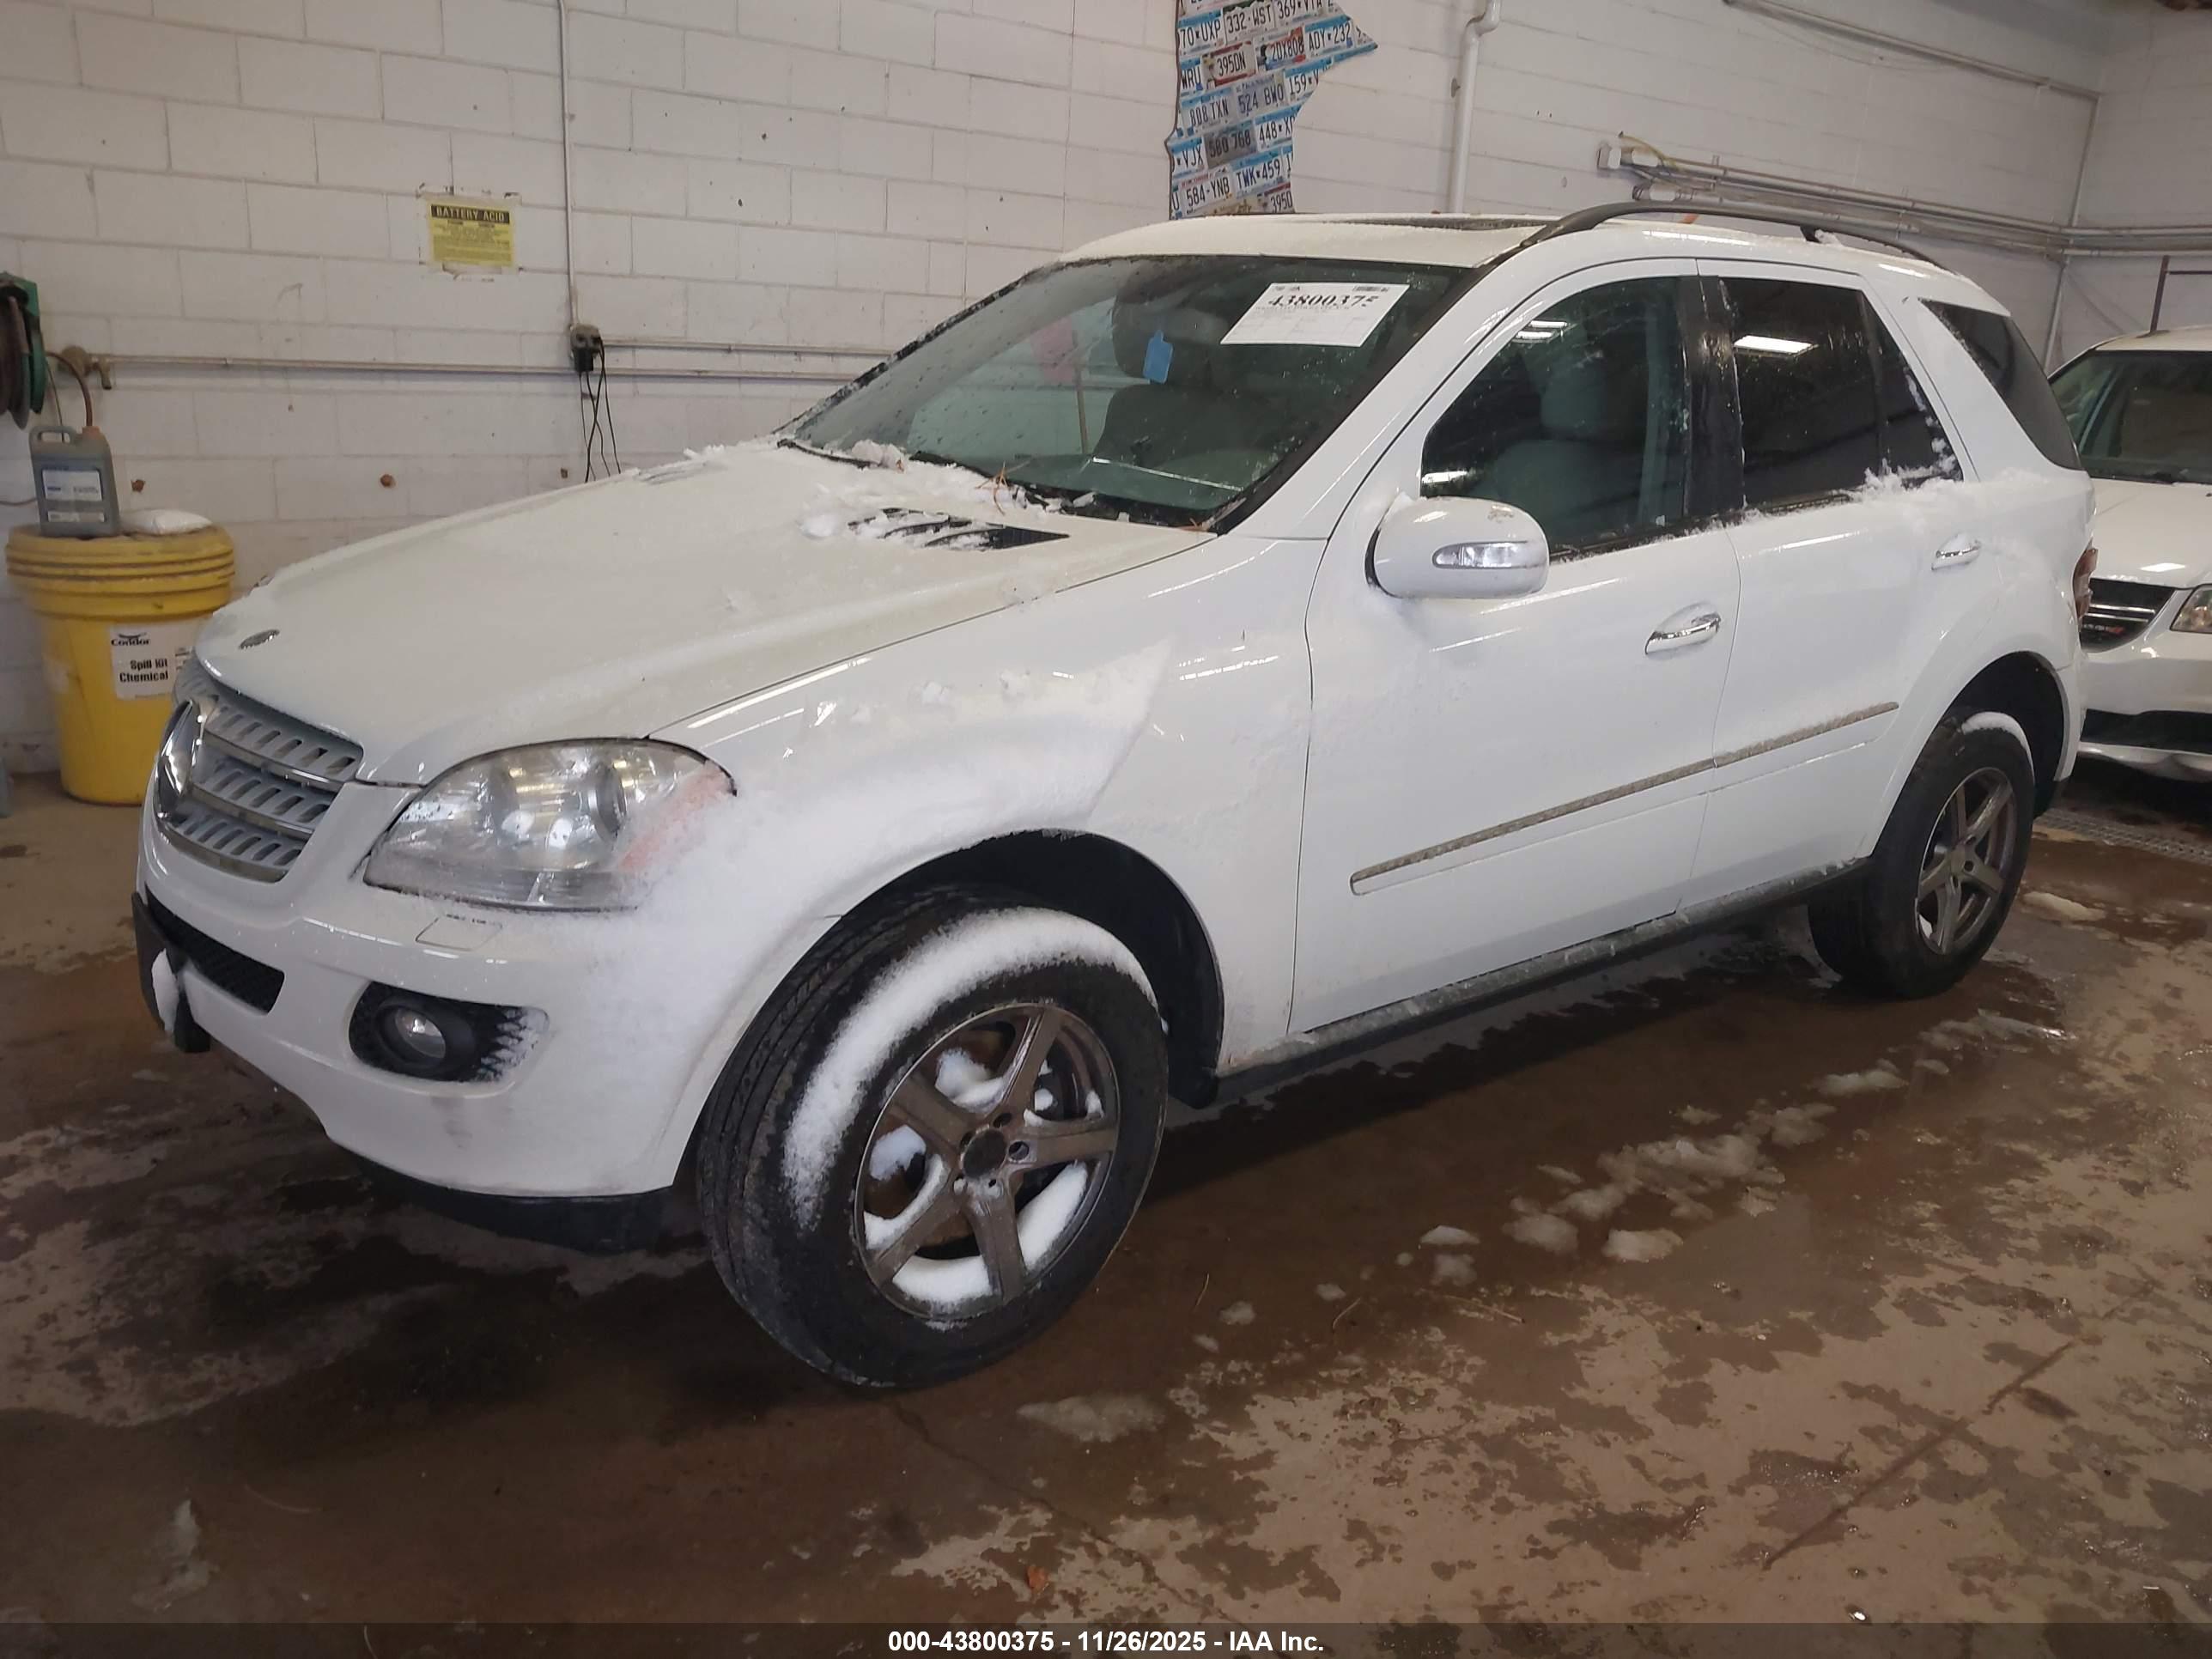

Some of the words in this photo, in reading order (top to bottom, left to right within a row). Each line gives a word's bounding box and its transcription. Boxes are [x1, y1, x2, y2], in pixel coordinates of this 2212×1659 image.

[1177, 27, 1194, 48] 70
[436, 205, 478, 221] BATTERY
[483, 212, 505, 222] ACID
[111, 637, 150, 647] Condor
[130, 659, 152, 671] Spill
[155, 658, 168, 668] Kit
[119, 670, 169, 683] Chemical
